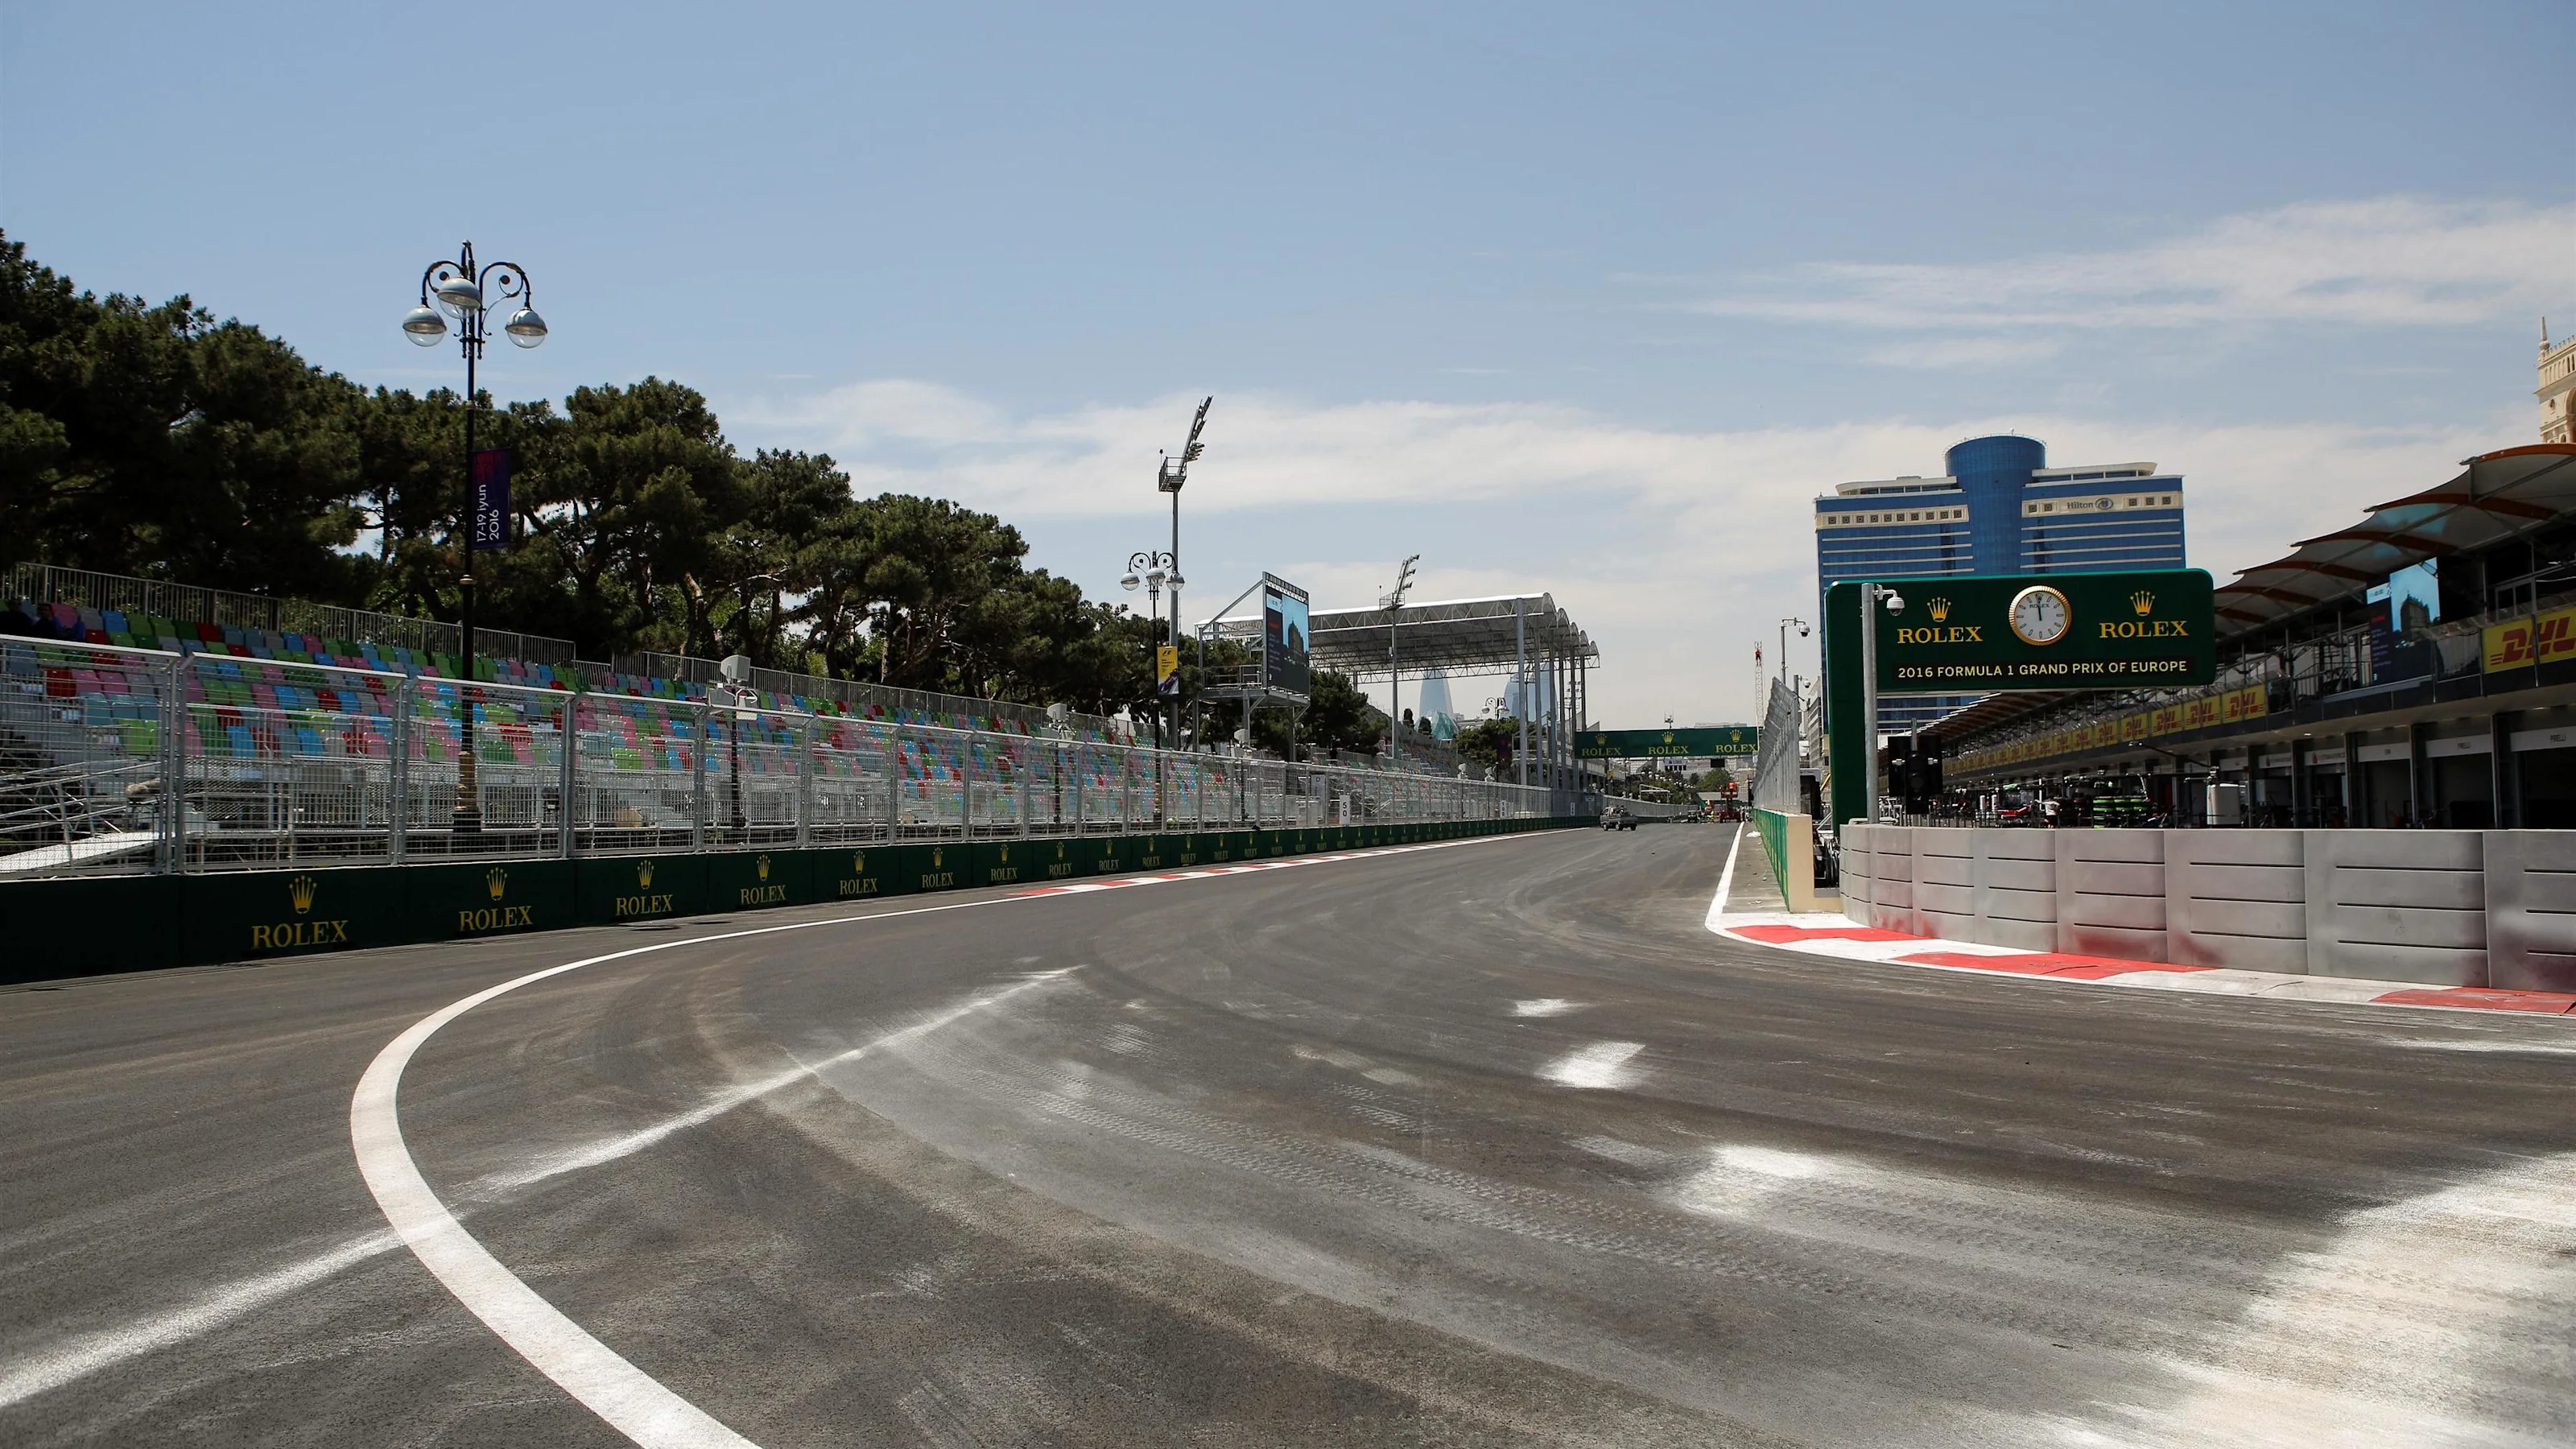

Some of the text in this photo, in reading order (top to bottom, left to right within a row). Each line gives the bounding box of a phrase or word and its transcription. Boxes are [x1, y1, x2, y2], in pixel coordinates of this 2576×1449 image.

[477, 484, 489, 543] 17-19 iyun
[489, 509, 500, 541] 2016
[1897, 625, 1983, 644] ROLEX
[2100, 620, 2190, 639] ROLEX
[2502, 617, 2576, 664] DHL
[1898, 660, 2187, 679] 2016 FORMULA 1 GRAND PRIX OF EUROPE
[1582, 747, 1621, 757] ROLEX
[1648, 745, 1689, 755] ROLEX
[1715, 743, 1756, 754] ROLEX
[1342, 802, 1348, 817] 50
[1049, 862, 1072, 877] ROLEX
[1099, 859, 1120, 872] ROLEX
[1142, 856, 1161, 867] ROLEX
[922, 872, 953, 889] ROLEX
[990, 867, 1018, 881] ROLEX
[741, 885, 786, 905] ROLEX
[840, 877, 877, 897] ROLEX
[616, 894, 672, 916] ROLEX
[459, 905, 532, 932] ROLEX
[251, 919, 348, 950] ROLEX
